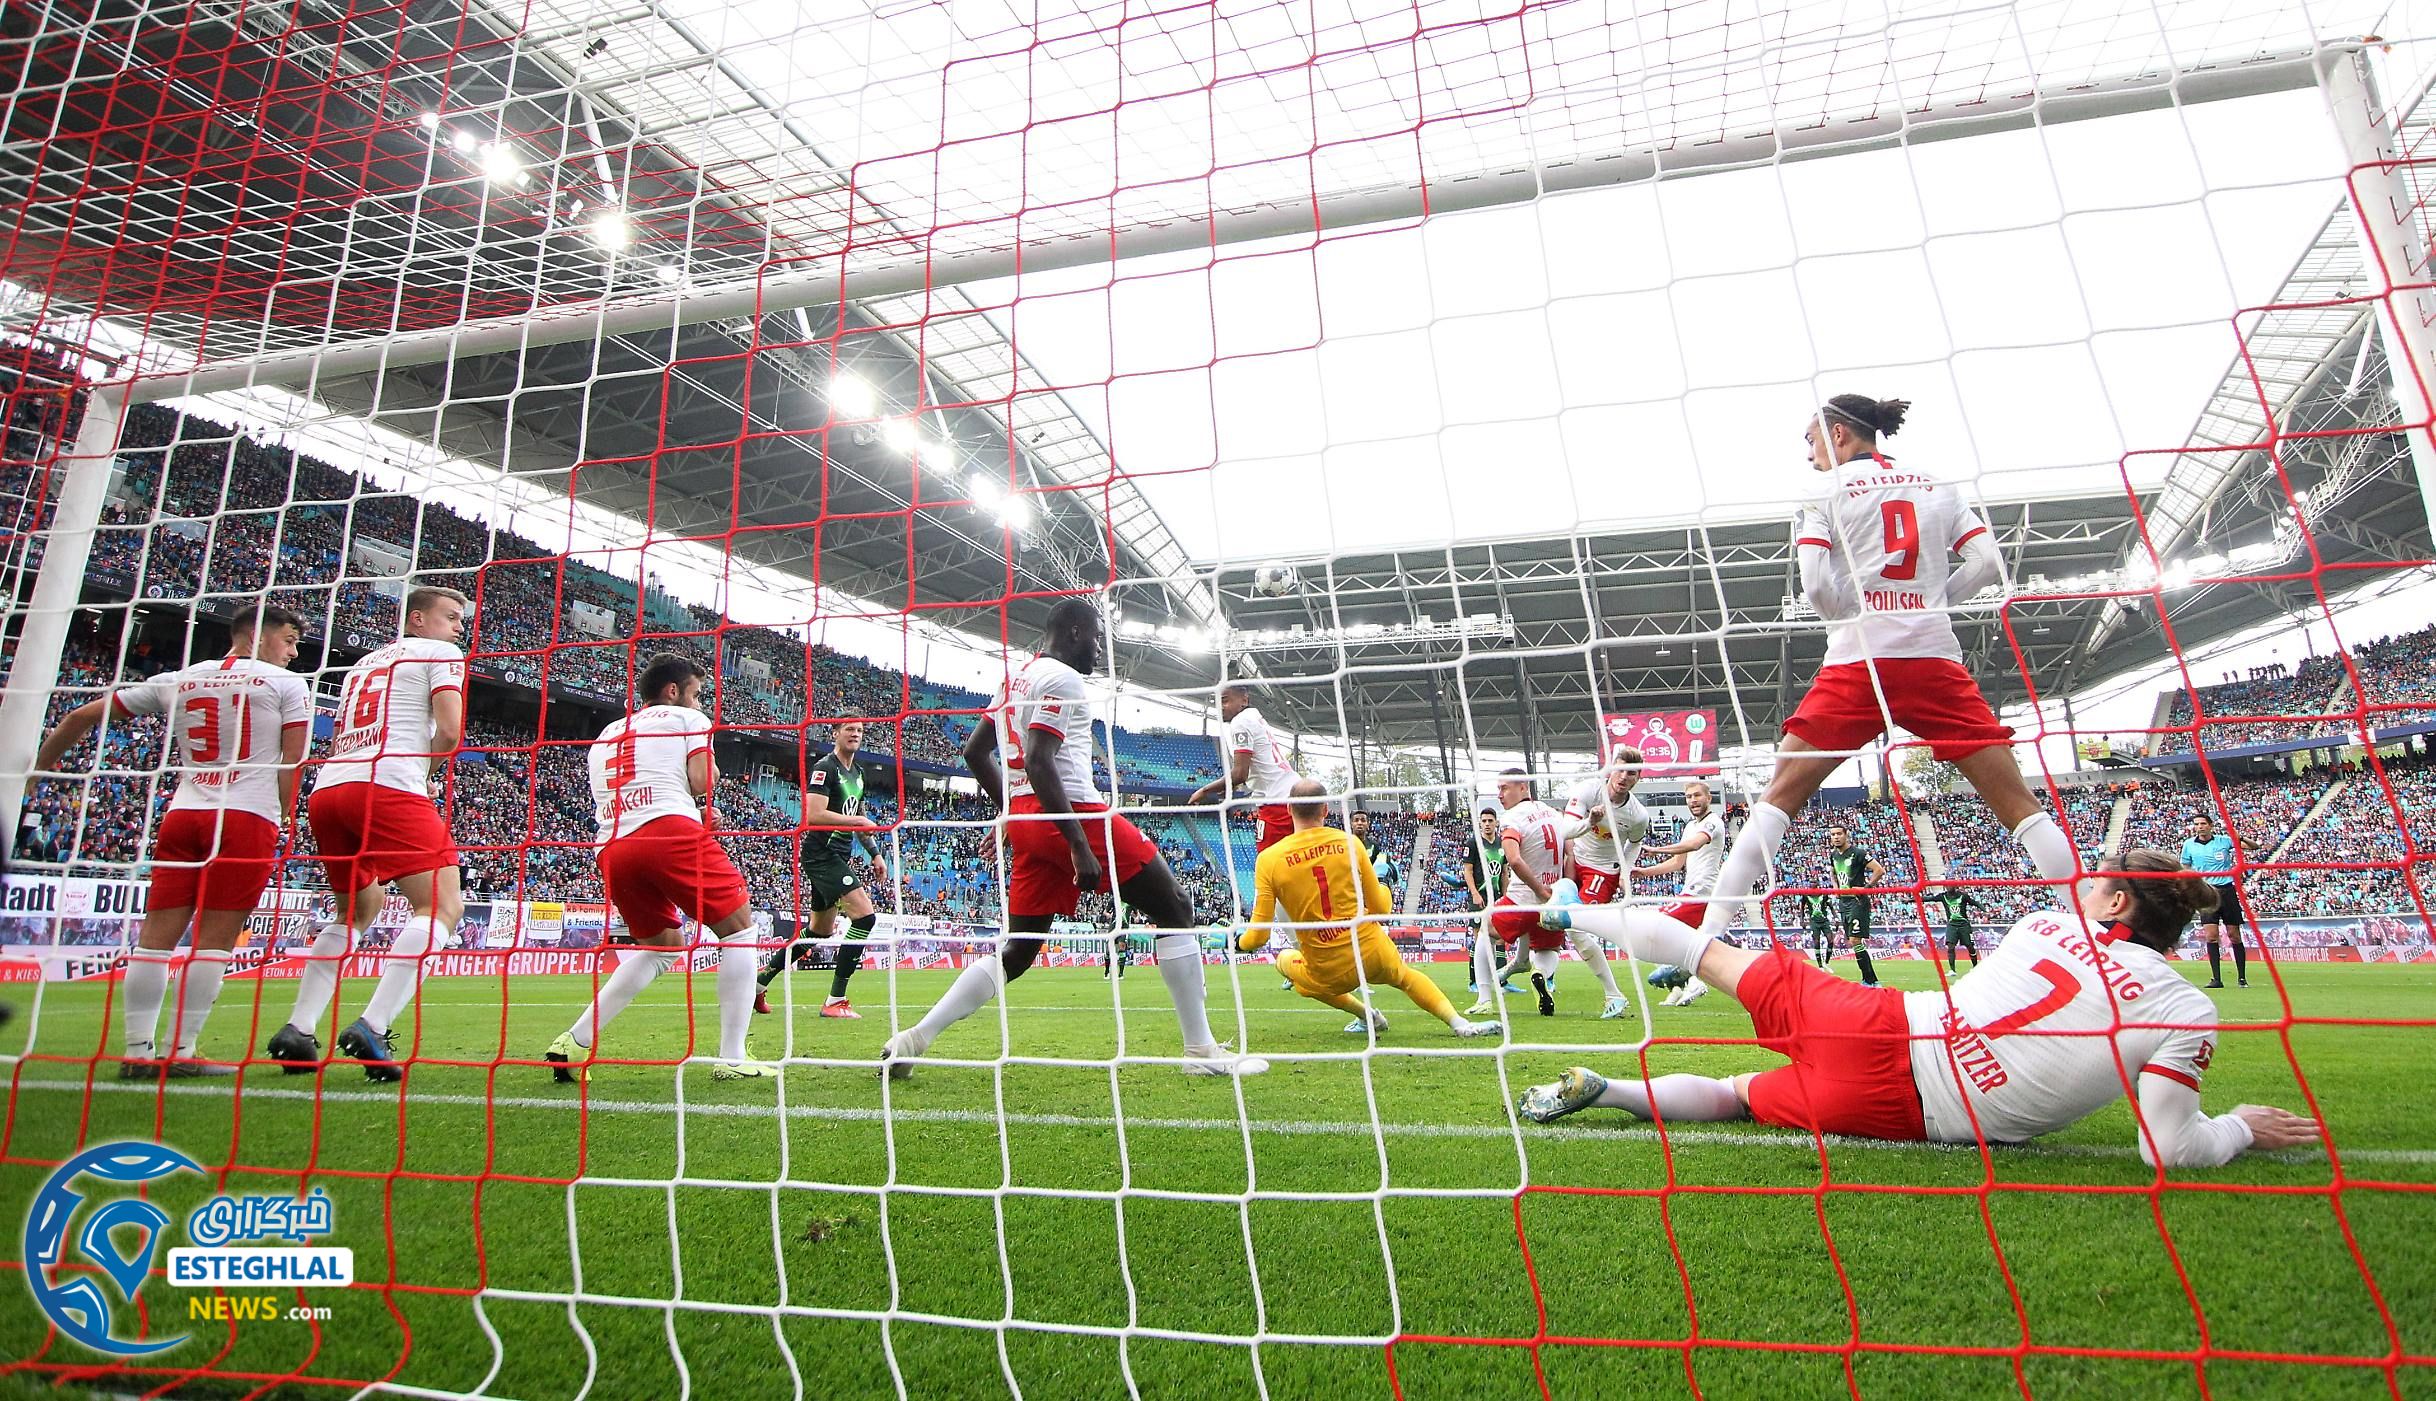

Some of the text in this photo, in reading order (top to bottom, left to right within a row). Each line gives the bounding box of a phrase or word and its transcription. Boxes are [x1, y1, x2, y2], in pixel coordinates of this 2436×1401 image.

[1880, 499, 1920, 581] 9
[203, 674, 265, 688] LEIPZG
[340, 667, 390, 735] 16
[185, 692, 252, 763] 31
[605, 730, 637, 790] 3
[1285, 844, 1345, 867] RB LEIPZIG
[1541, 823, 1559, 866] 4
[1311, 865, 1333, 921] 1
[1317, 916, 1353, 943] GULA
[1851, 919, 1861, 931] 2
[2027, 919, 2060, 936] RB
[15, 968, 41, 980] KIES
[66, 946, 134, 980] FENG
[224, 946, 287, 975] ENGER
[693, 949, 723, 971] FENGE
[880, 952, 905, 970] FEGER
[1980, 958, 2082, 1041] 7
